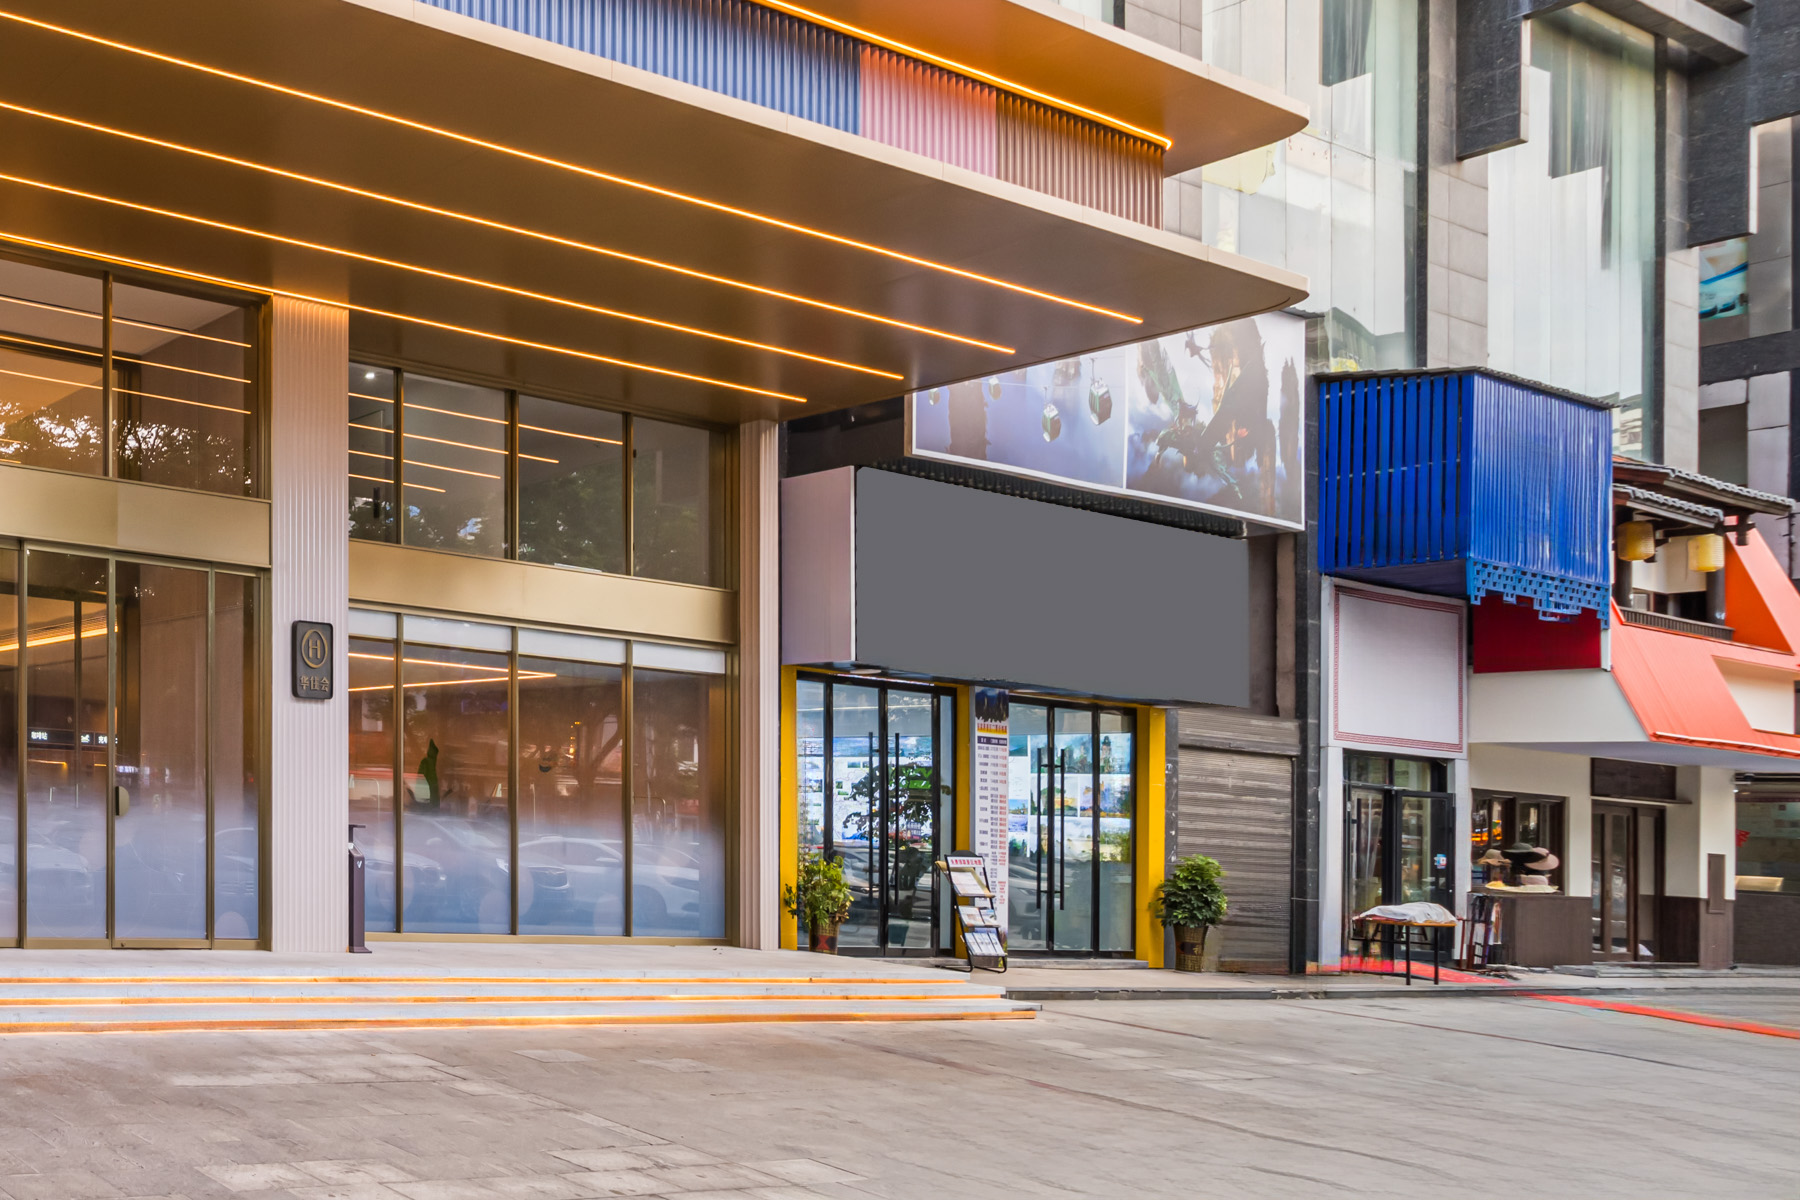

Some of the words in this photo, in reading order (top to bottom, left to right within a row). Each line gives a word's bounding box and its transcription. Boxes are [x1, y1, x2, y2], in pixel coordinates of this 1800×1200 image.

[308, 638, 321, 659] H
[299, 675, 330, 692] 华住会
